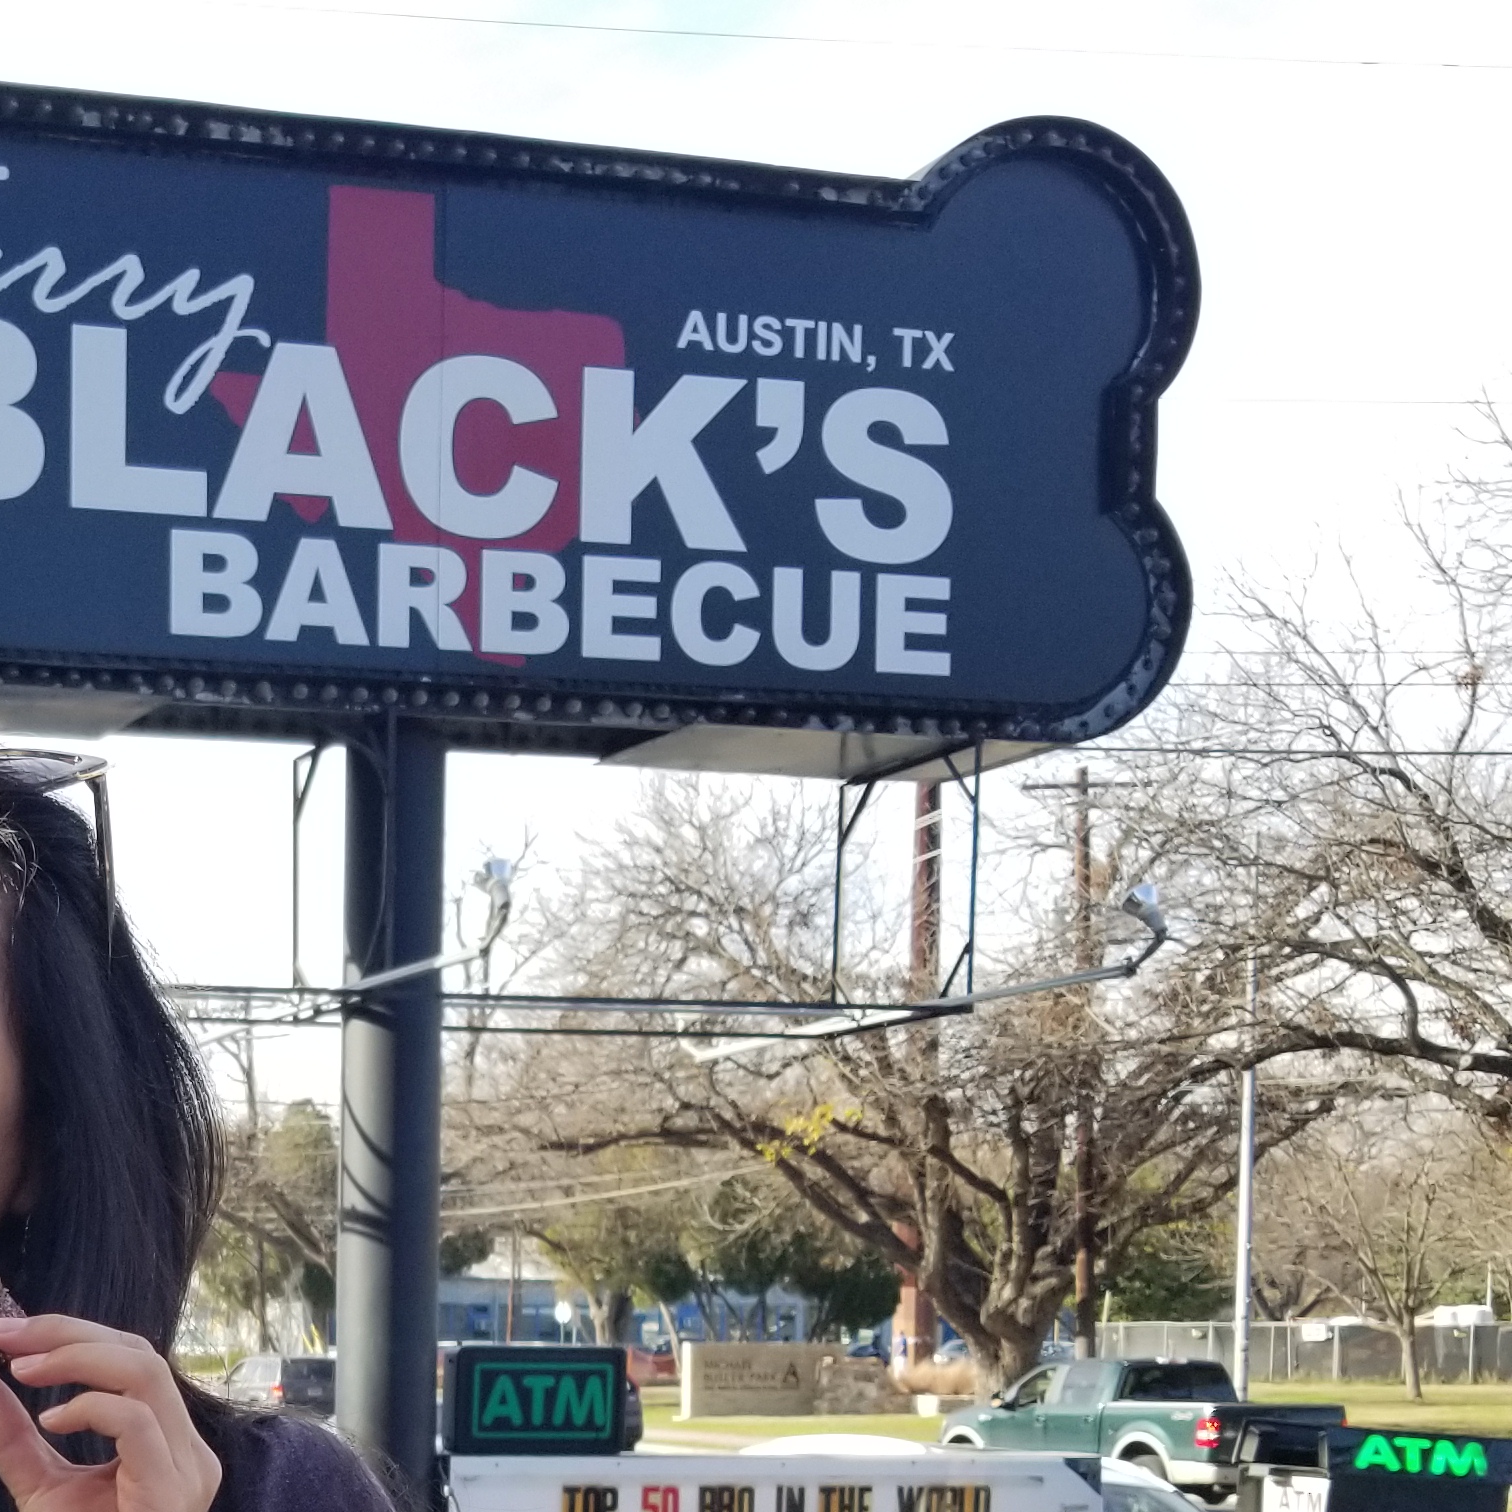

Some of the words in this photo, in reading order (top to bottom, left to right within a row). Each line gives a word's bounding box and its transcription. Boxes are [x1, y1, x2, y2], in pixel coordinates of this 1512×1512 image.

[677, 310, 877, 372] AUSTIN,
[893, 328, 955, 371] TX
[169, 528, 952, 677] BARBECUE
[482, 1374, 609, 1428] ATM
[1354, 1434, 1487, 1477] ATM
